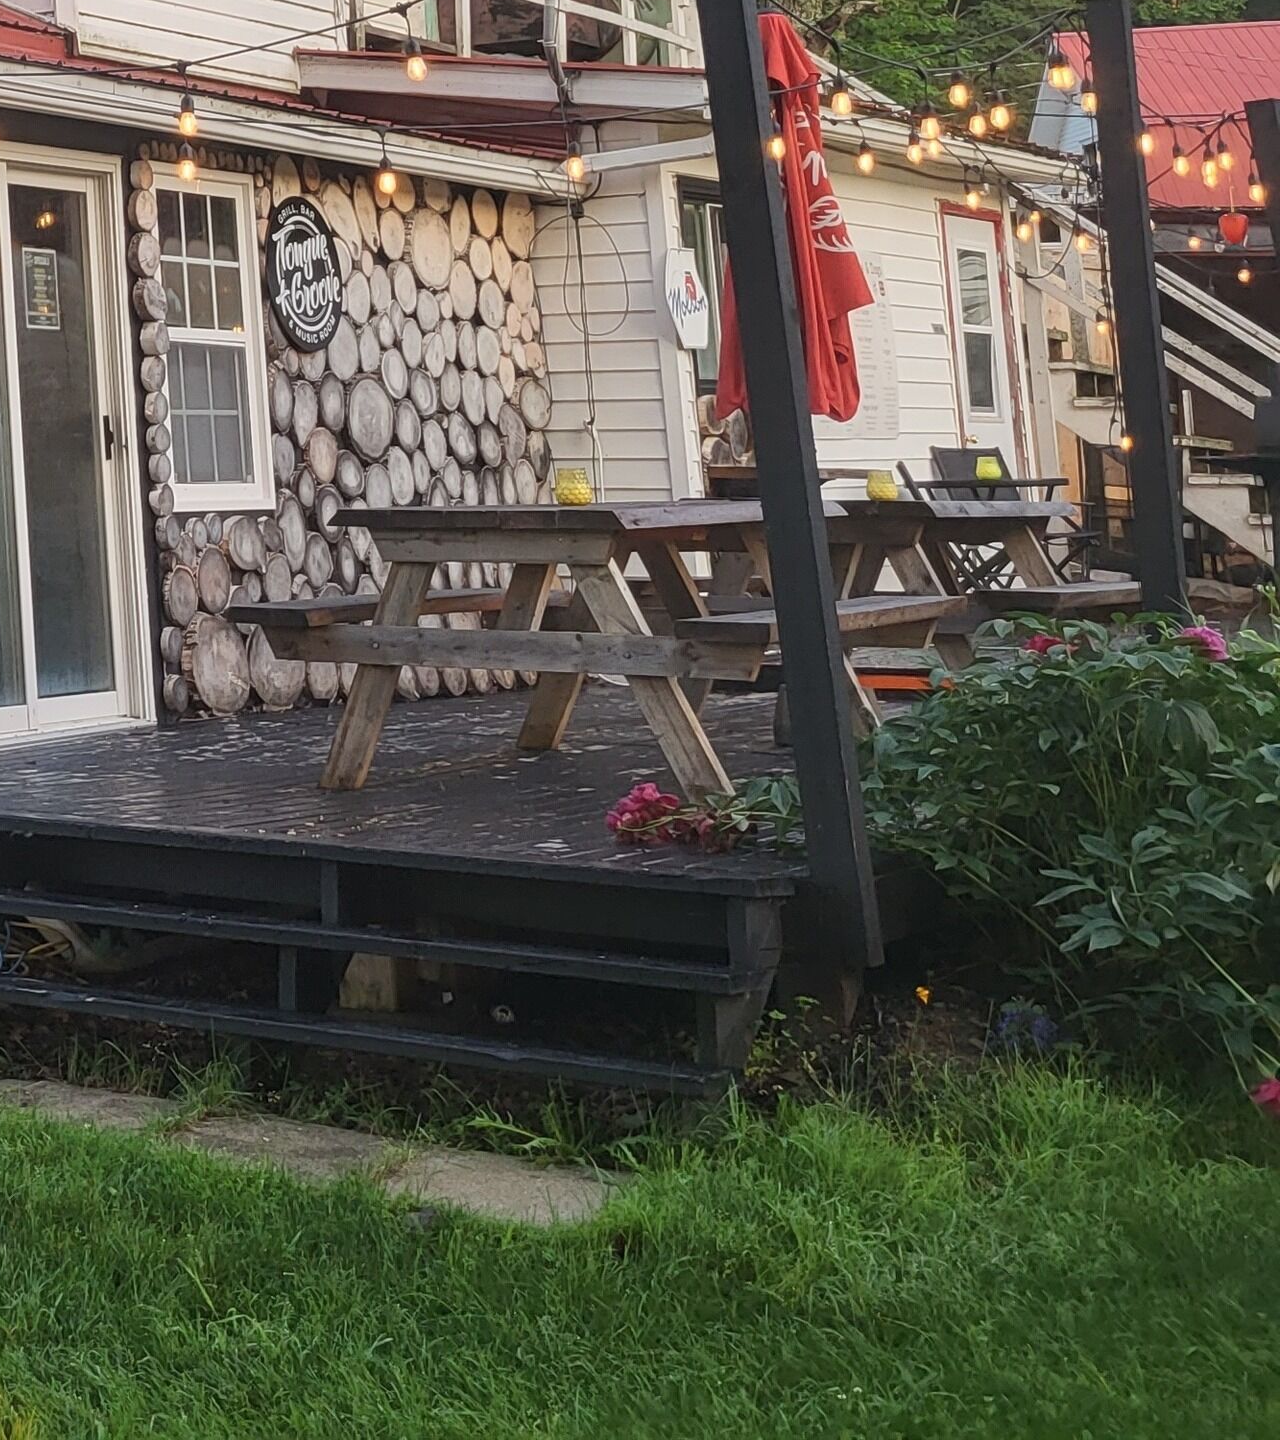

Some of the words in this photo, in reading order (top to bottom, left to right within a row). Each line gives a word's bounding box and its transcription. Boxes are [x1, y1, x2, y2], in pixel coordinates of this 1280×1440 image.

[300, 204, 316, 222] BAR
[272, 223, 328, 281] Tongue
[291, 268, 341, 317] Groove
[668, 286, 708, 329] Molson
[295, 327, 319, 344] MUSIC
[319, 314, 336, 340] ROOM
